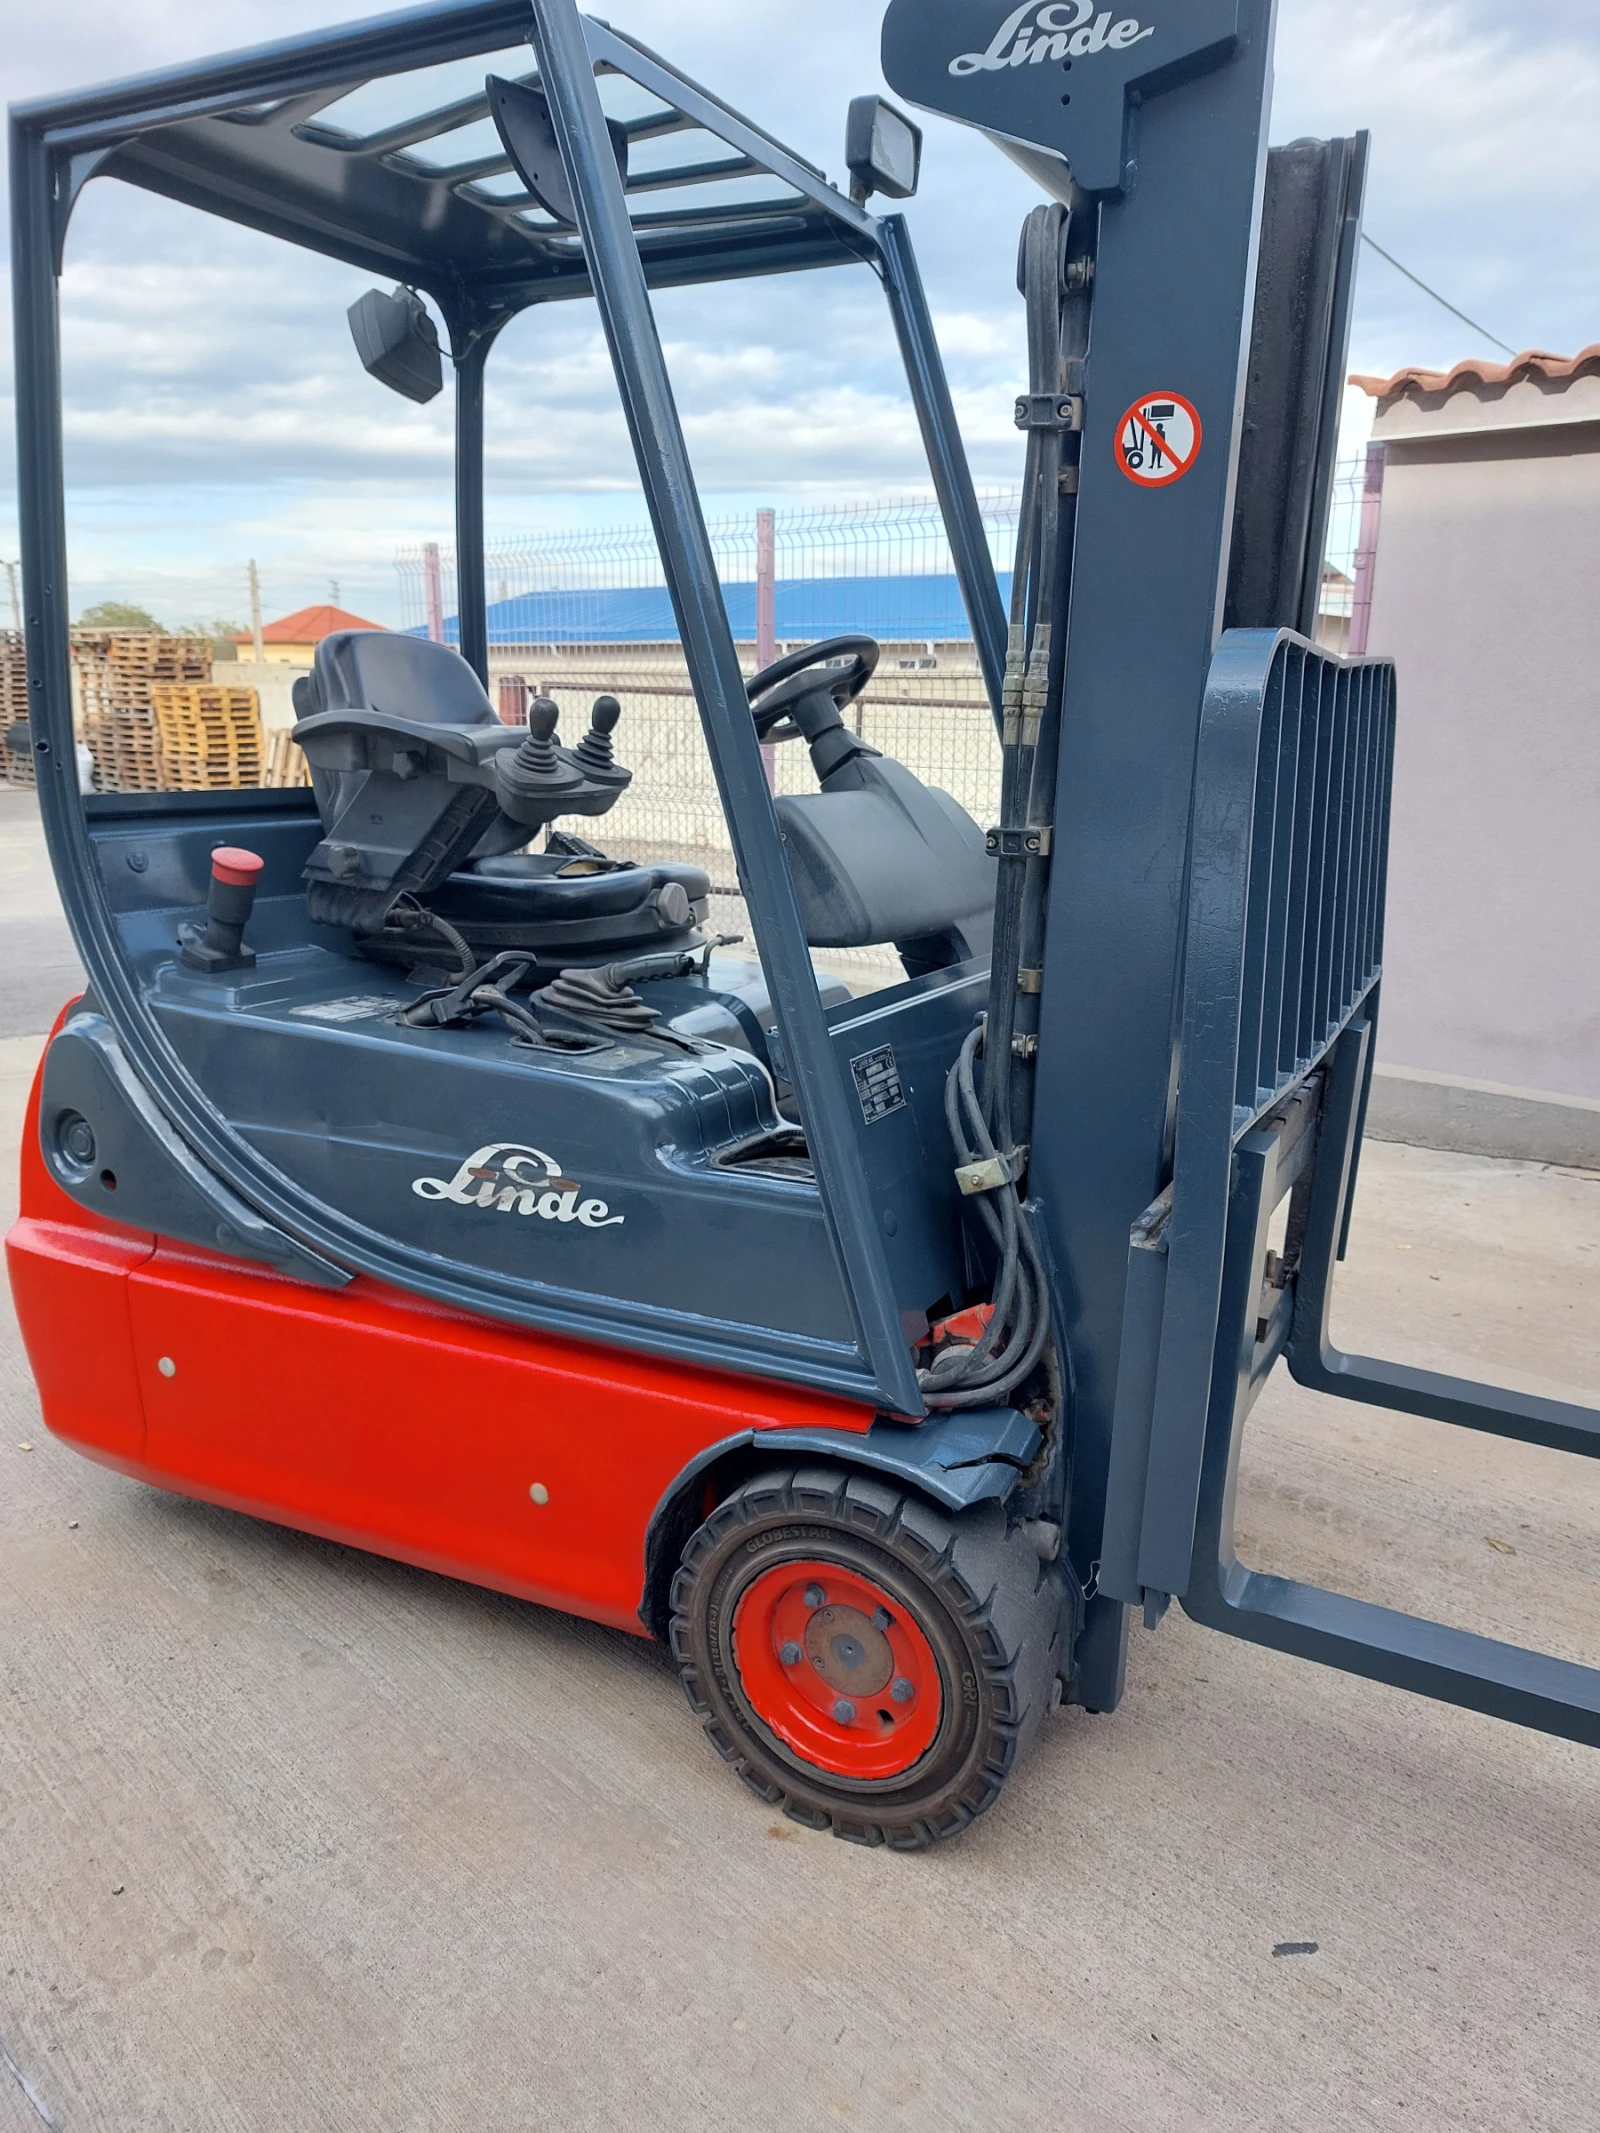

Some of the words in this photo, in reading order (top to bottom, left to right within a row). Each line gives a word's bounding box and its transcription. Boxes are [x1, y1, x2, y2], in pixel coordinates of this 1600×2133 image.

[948, 0, 1155, 76] Linde
[411, 1142, 624, 1228] Linde
[746, 1525, 832, 1553] GLOBESTAR
[961, 1671, 978, 1707] GRI
